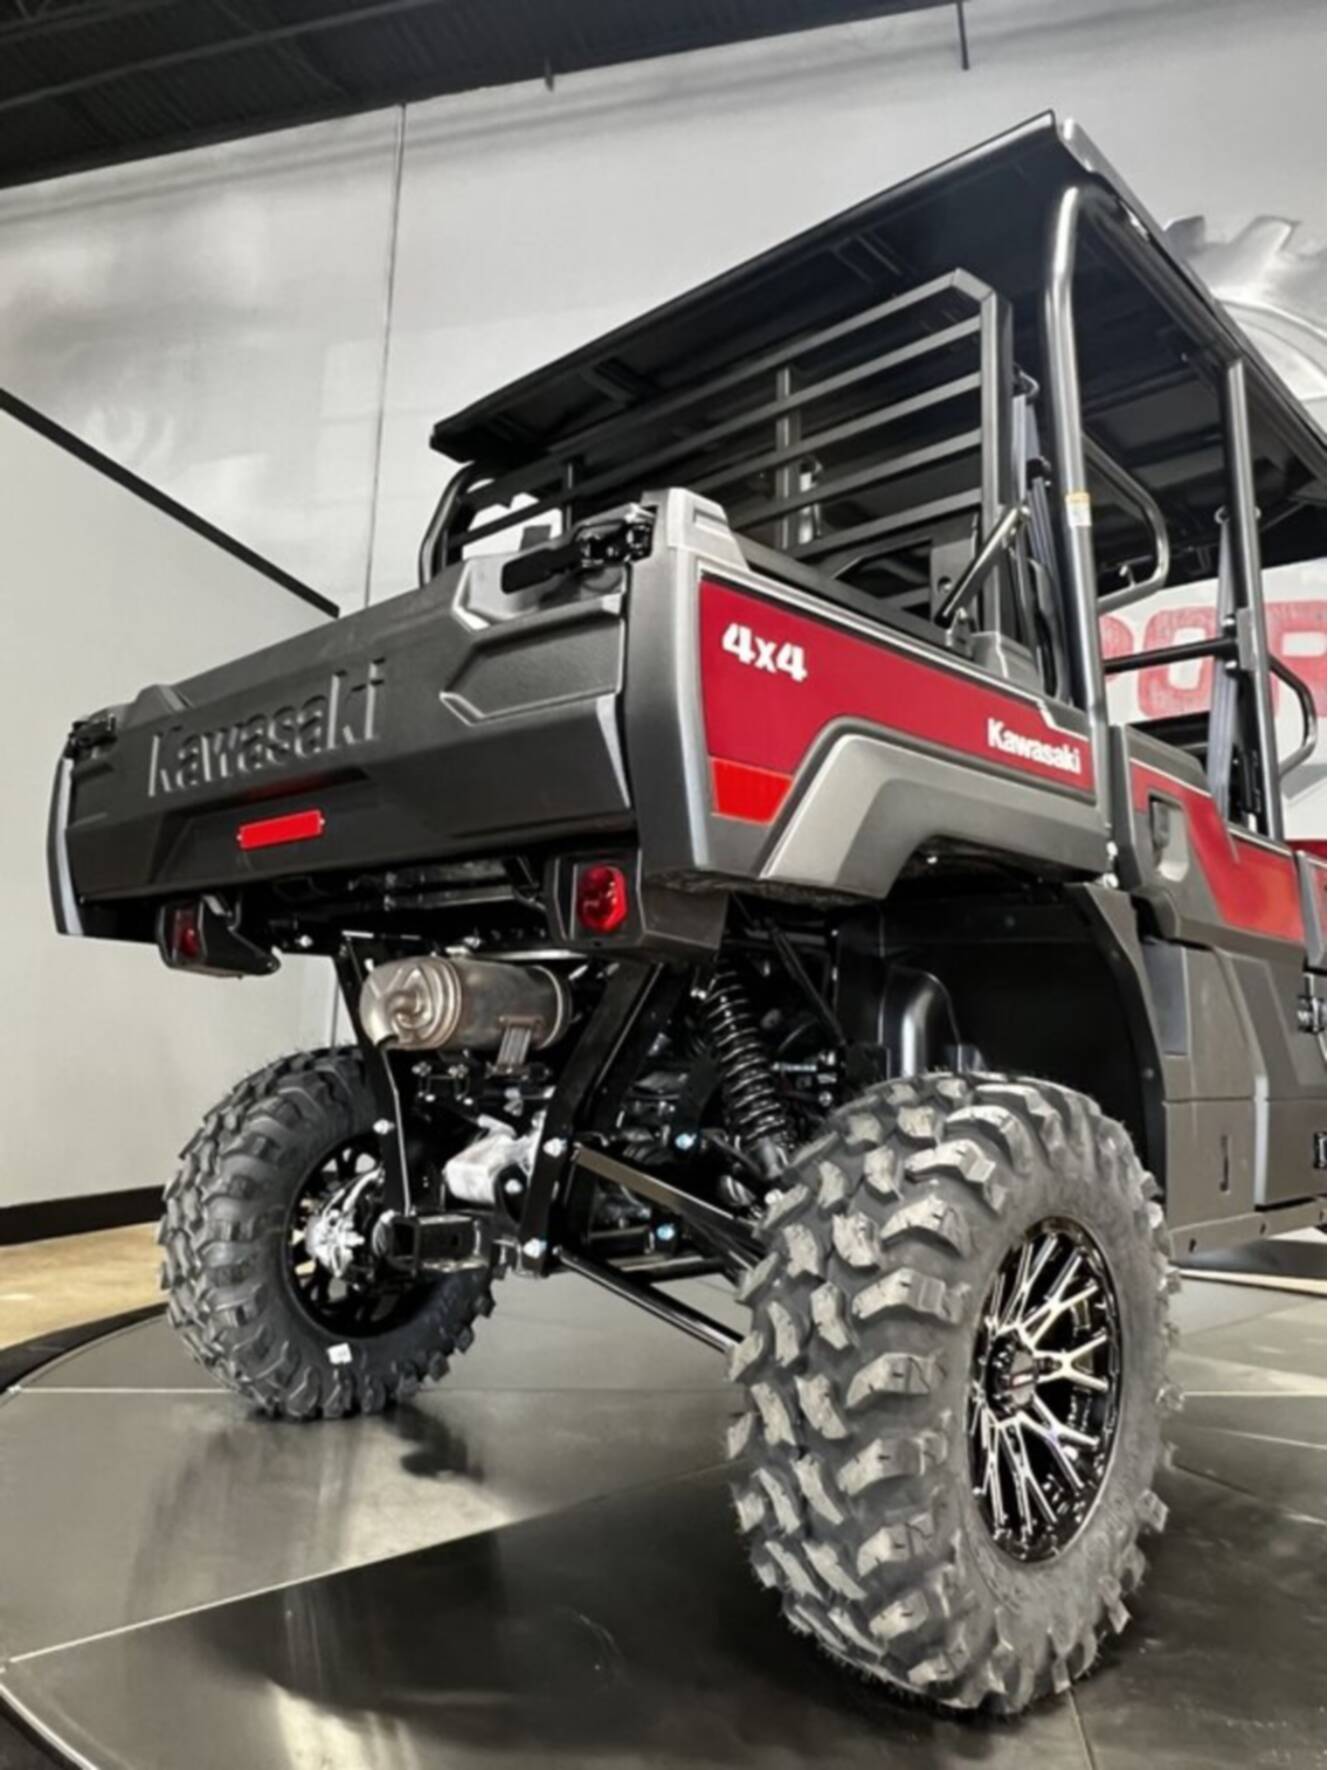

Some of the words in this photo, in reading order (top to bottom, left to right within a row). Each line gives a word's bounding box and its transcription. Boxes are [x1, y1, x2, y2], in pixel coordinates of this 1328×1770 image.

[721, 621, 808, 683] 4x4
[147, 657, 386, 798] Kawasaki
[987, 717, 1082, 775] Kawasaki
